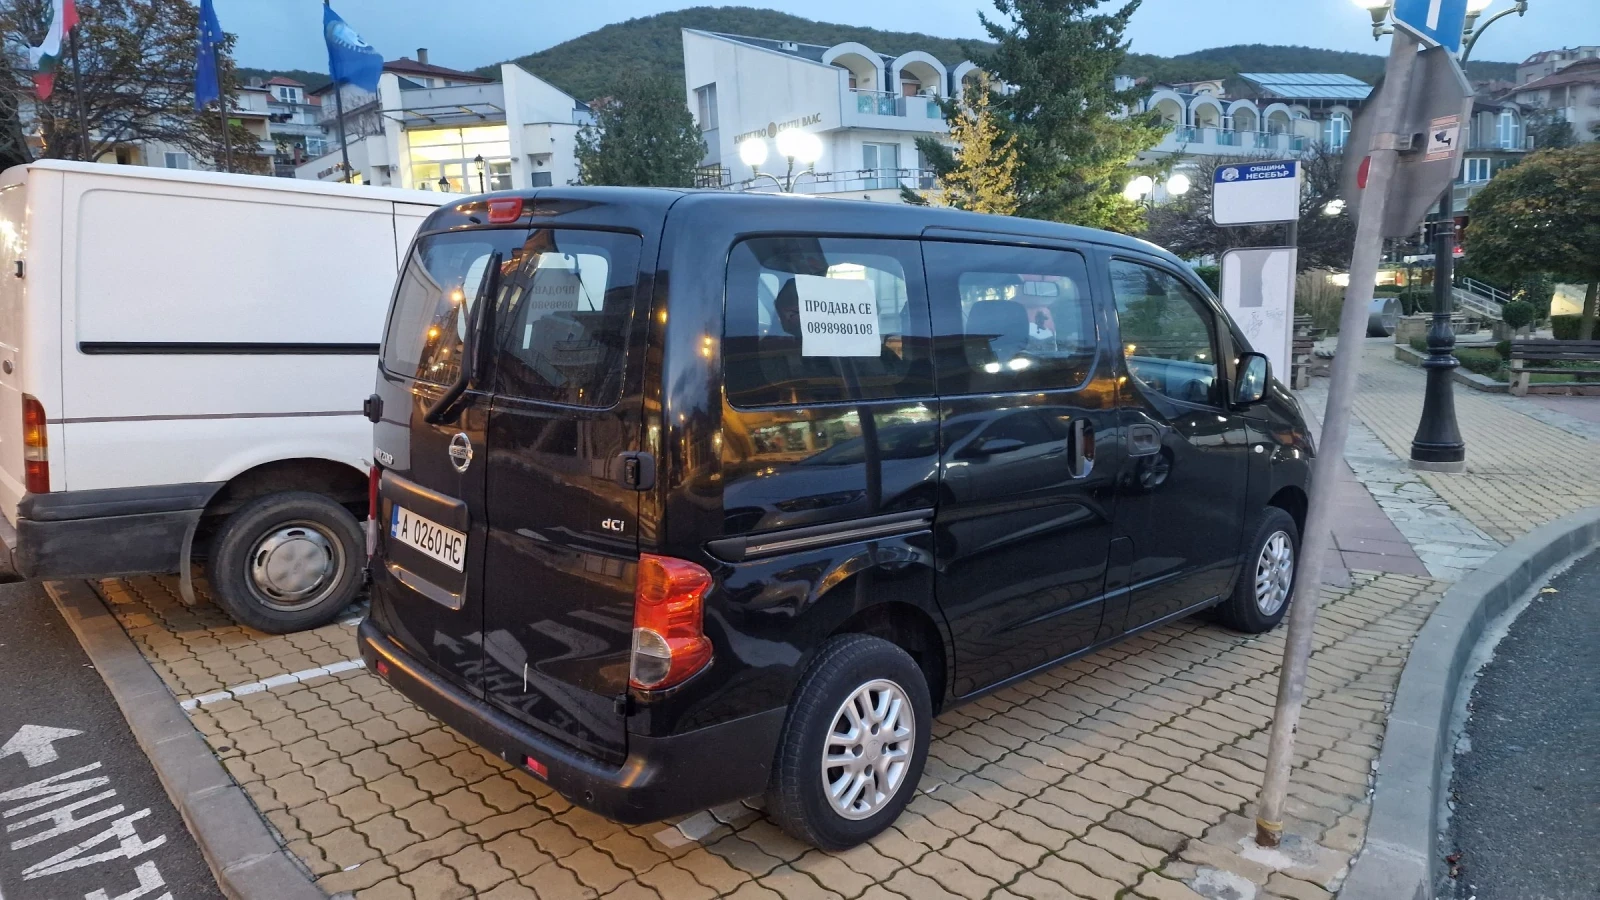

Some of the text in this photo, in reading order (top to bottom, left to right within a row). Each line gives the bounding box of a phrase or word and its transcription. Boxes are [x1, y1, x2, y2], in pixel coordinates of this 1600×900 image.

[801, 112, 822, 127] ВЛАС
[1249, 163, 1286, 172] ОБЩИНА
[1245, 170, 1290, 180] НЕСЕБЪР
[804, 300, 872, 316] ПРОДАВА СЕ
[807, 321, 873, 335] 0898980108
[601, 518, 625, 532] dCi
